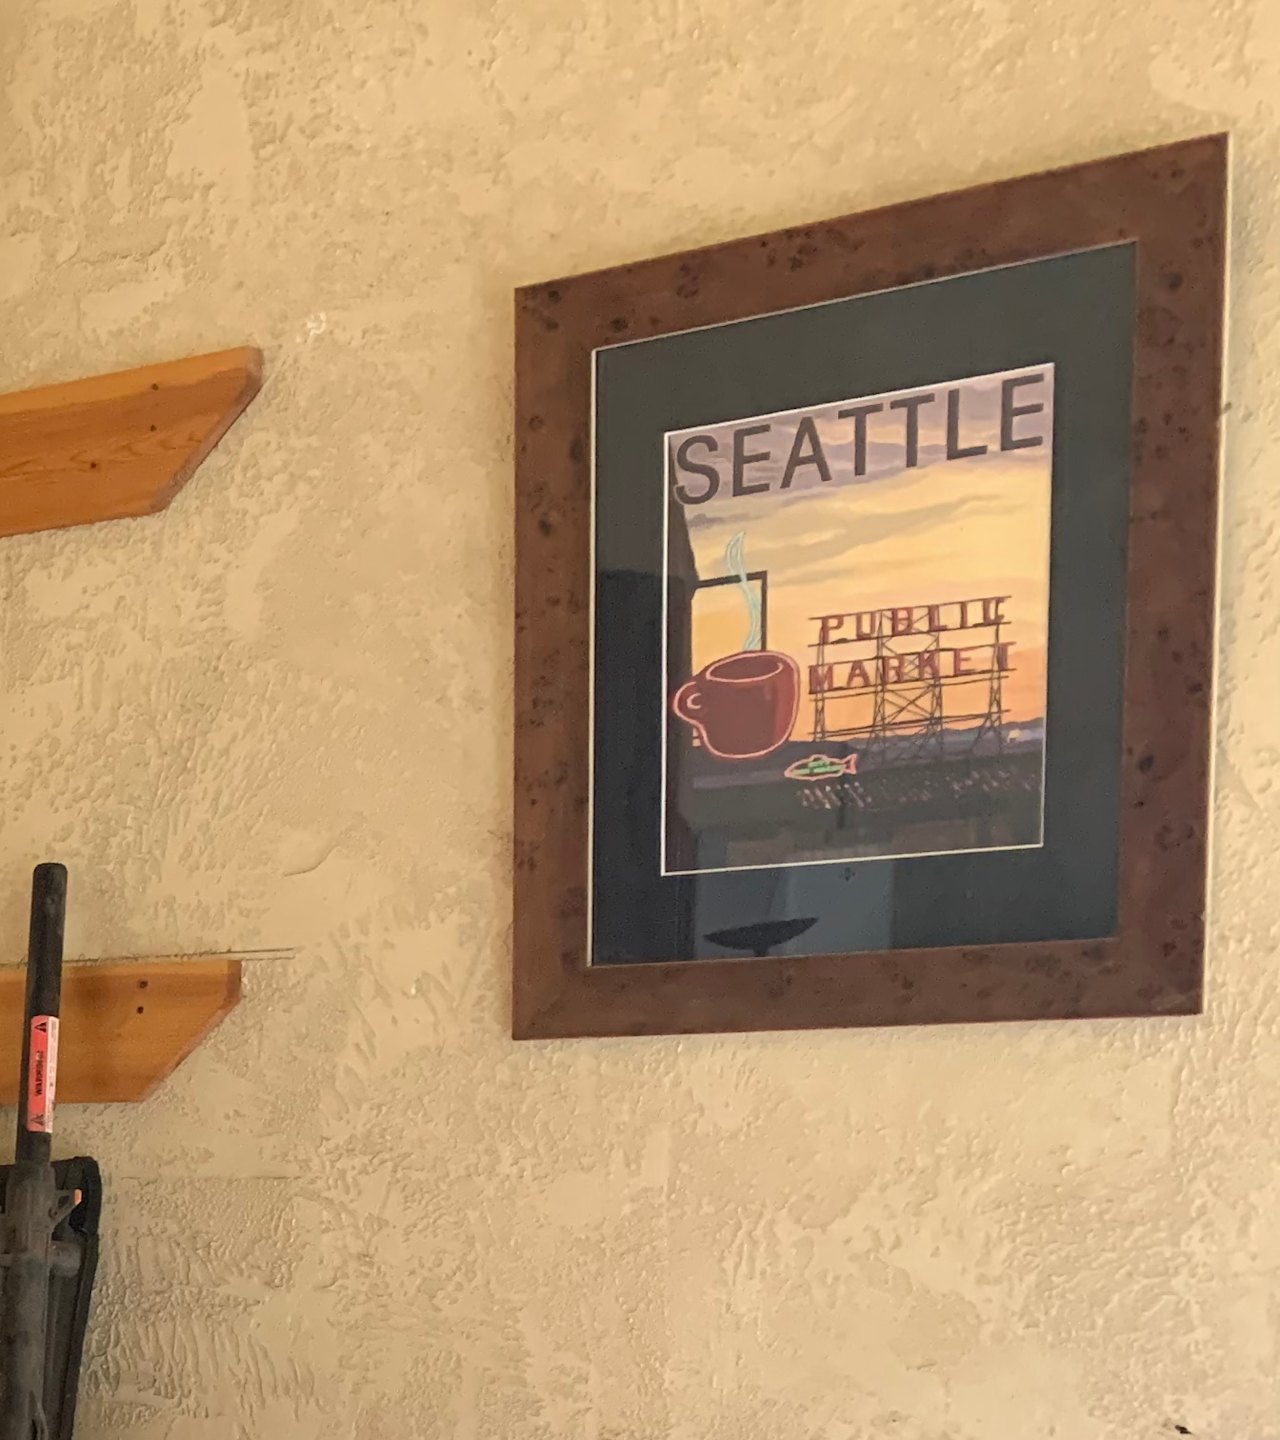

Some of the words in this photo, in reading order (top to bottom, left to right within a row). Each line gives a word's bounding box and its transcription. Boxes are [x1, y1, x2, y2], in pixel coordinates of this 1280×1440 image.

[675, 373, 1044, 505] SEATTLE
[821, 597, 1006, 644] PUBLIC
[808, 641, 1017, 694] MARKET
